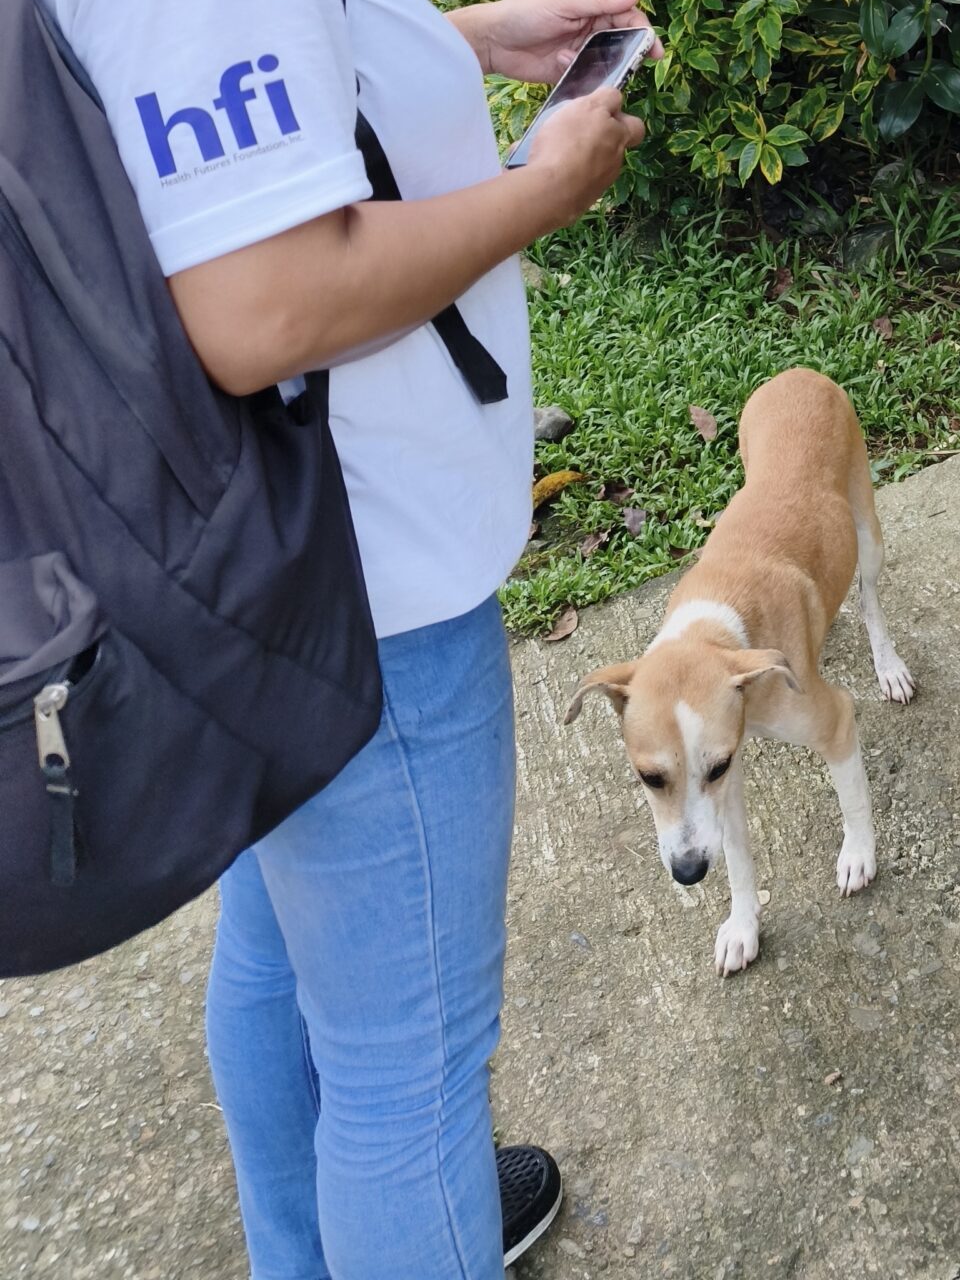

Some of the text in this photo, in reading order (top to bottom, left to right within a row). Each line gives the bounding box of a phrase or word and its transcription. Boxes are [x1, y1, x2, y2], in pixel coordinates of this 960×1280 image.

[135, 54, 301, 178] hfi
[160, 134, 305, 189] Health Futures Foundation, Inc.
